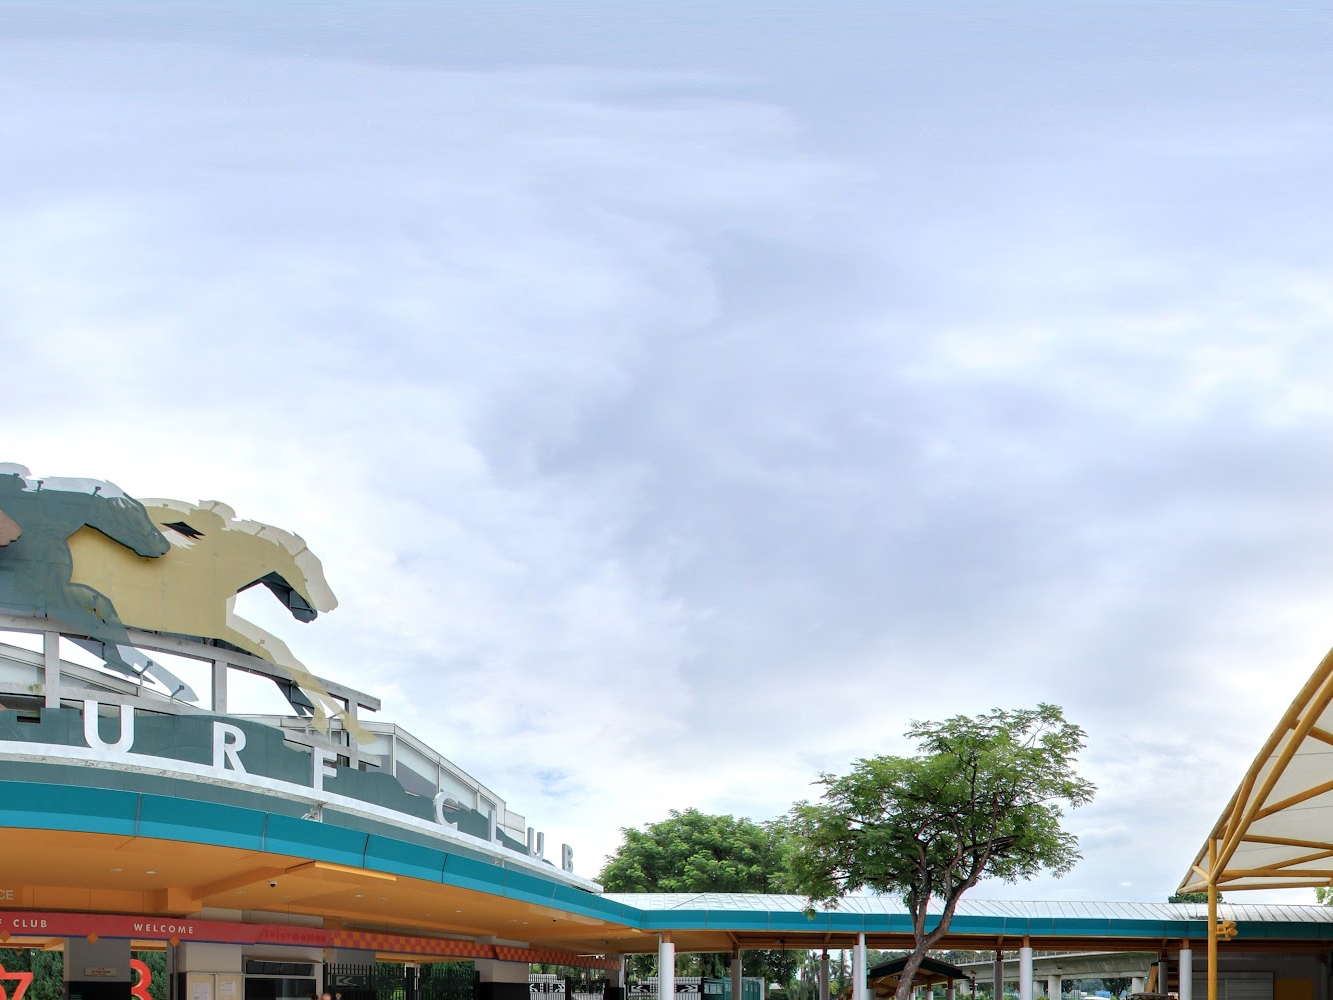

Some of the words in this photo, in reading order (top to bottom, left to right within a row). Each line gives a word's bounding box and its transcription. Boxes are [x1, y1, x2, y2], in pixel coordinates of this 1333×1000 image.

[433, 791, 573, 873] CLUB
[13, 919, 48, 928] CLUB
[134, 923, 194, 934] WELCOME
